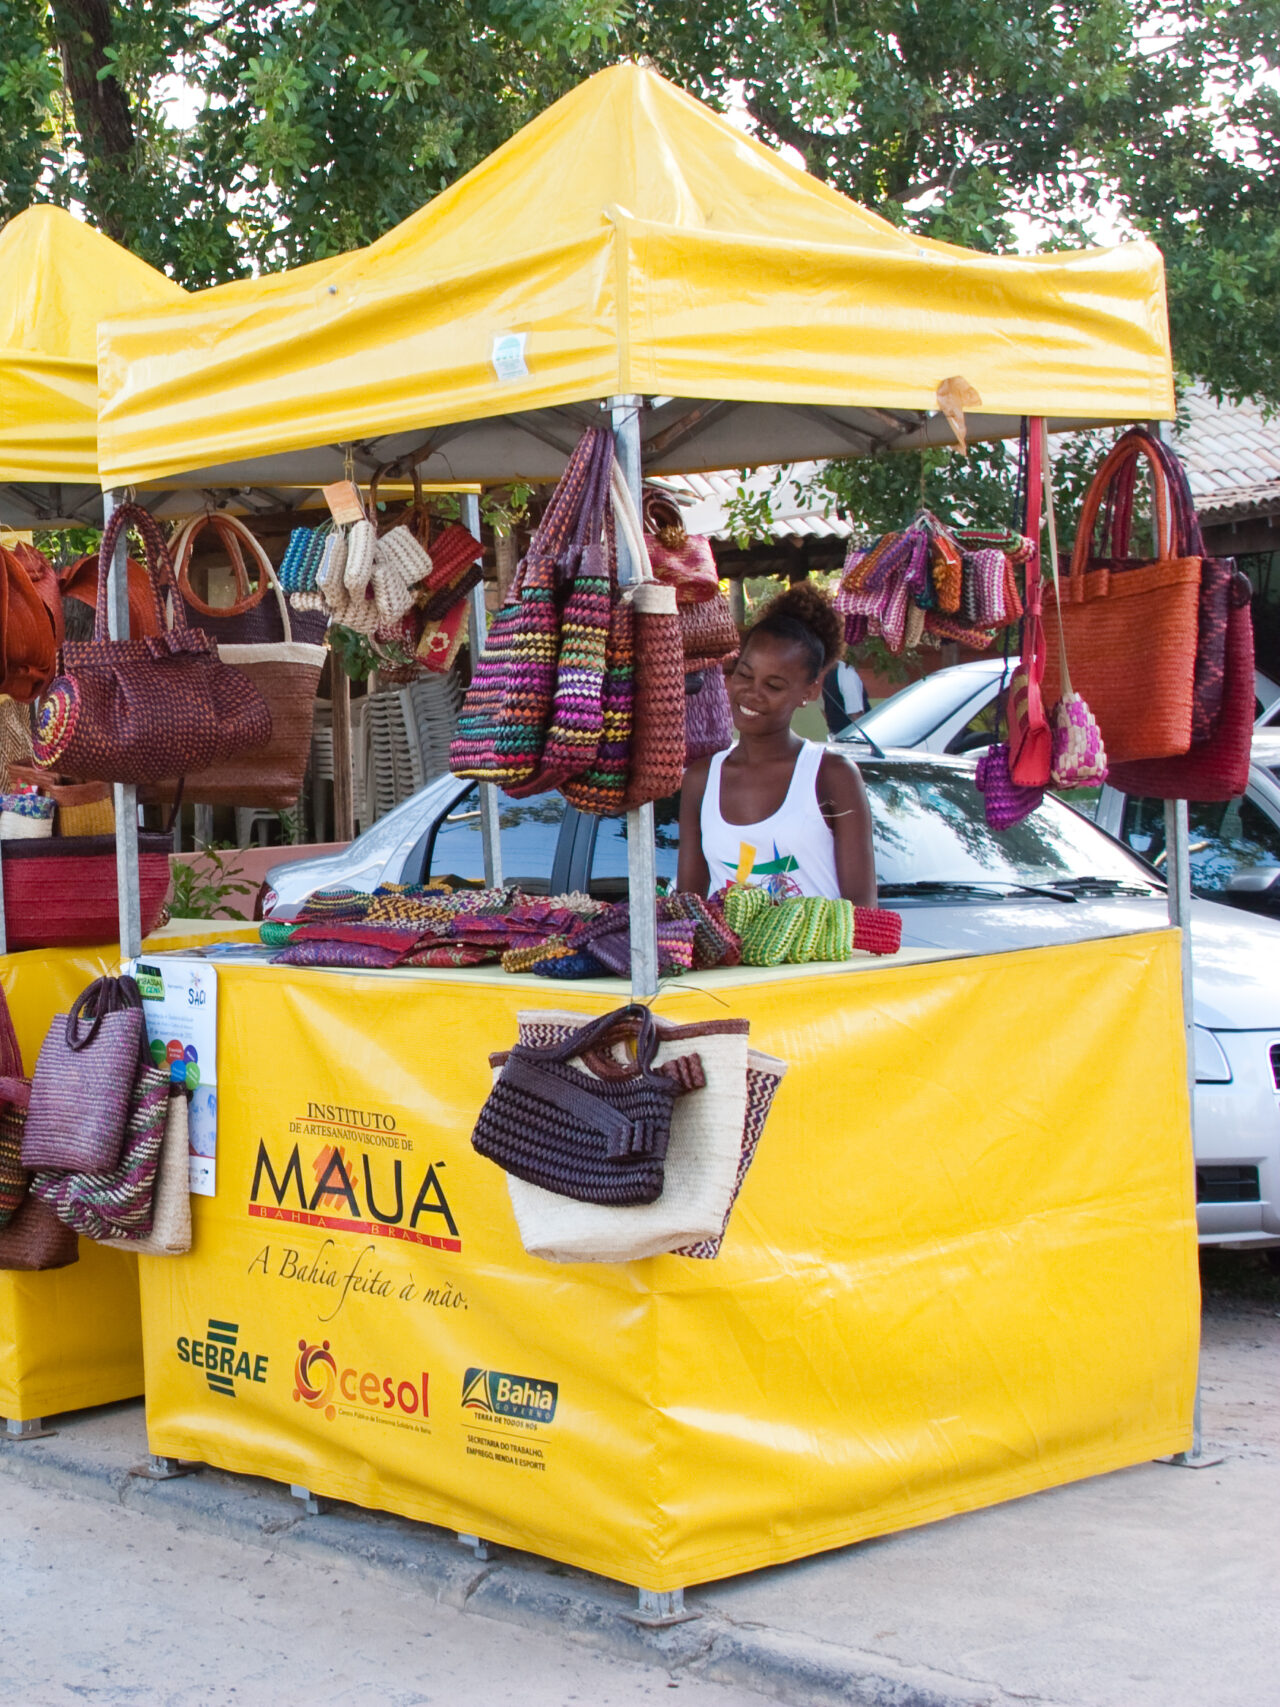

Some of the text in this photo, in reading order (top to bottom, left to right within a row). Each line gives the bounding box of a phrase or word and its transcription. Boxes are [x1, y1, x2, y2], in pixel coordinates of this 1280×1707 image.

[307, 1102, 397, 1131] INSTITUTO
[289, 1122, 414, 1151] DE ARTESANATO VISCONDE DE
[250, 1137, 460, 1237] MAUÁ
[260, 1207, 448, 1250] BAHIA BRASIL
[248, 1239, 469, 1322] A Bahia feita à mão.
[177, 1336, 269, 1384] SEBRAE
[340, 1368, 429, 1418] cesol
[497, 1378, 553, 1410] Bahia
[474, 1412, 493, 1423] TERRA
[494, 1416, 502, 1424] DE
[495, 1403, 551, 1420] GOVERNO
[466, 1447, 494, 1460] EMPREGO,
[495, 1453, 514, 1464] RENDA
[519, 1459, 546, 1471] ESPORTE
[467, 1434, 544, 1459] SECRETARIA DO TRABALHO,
